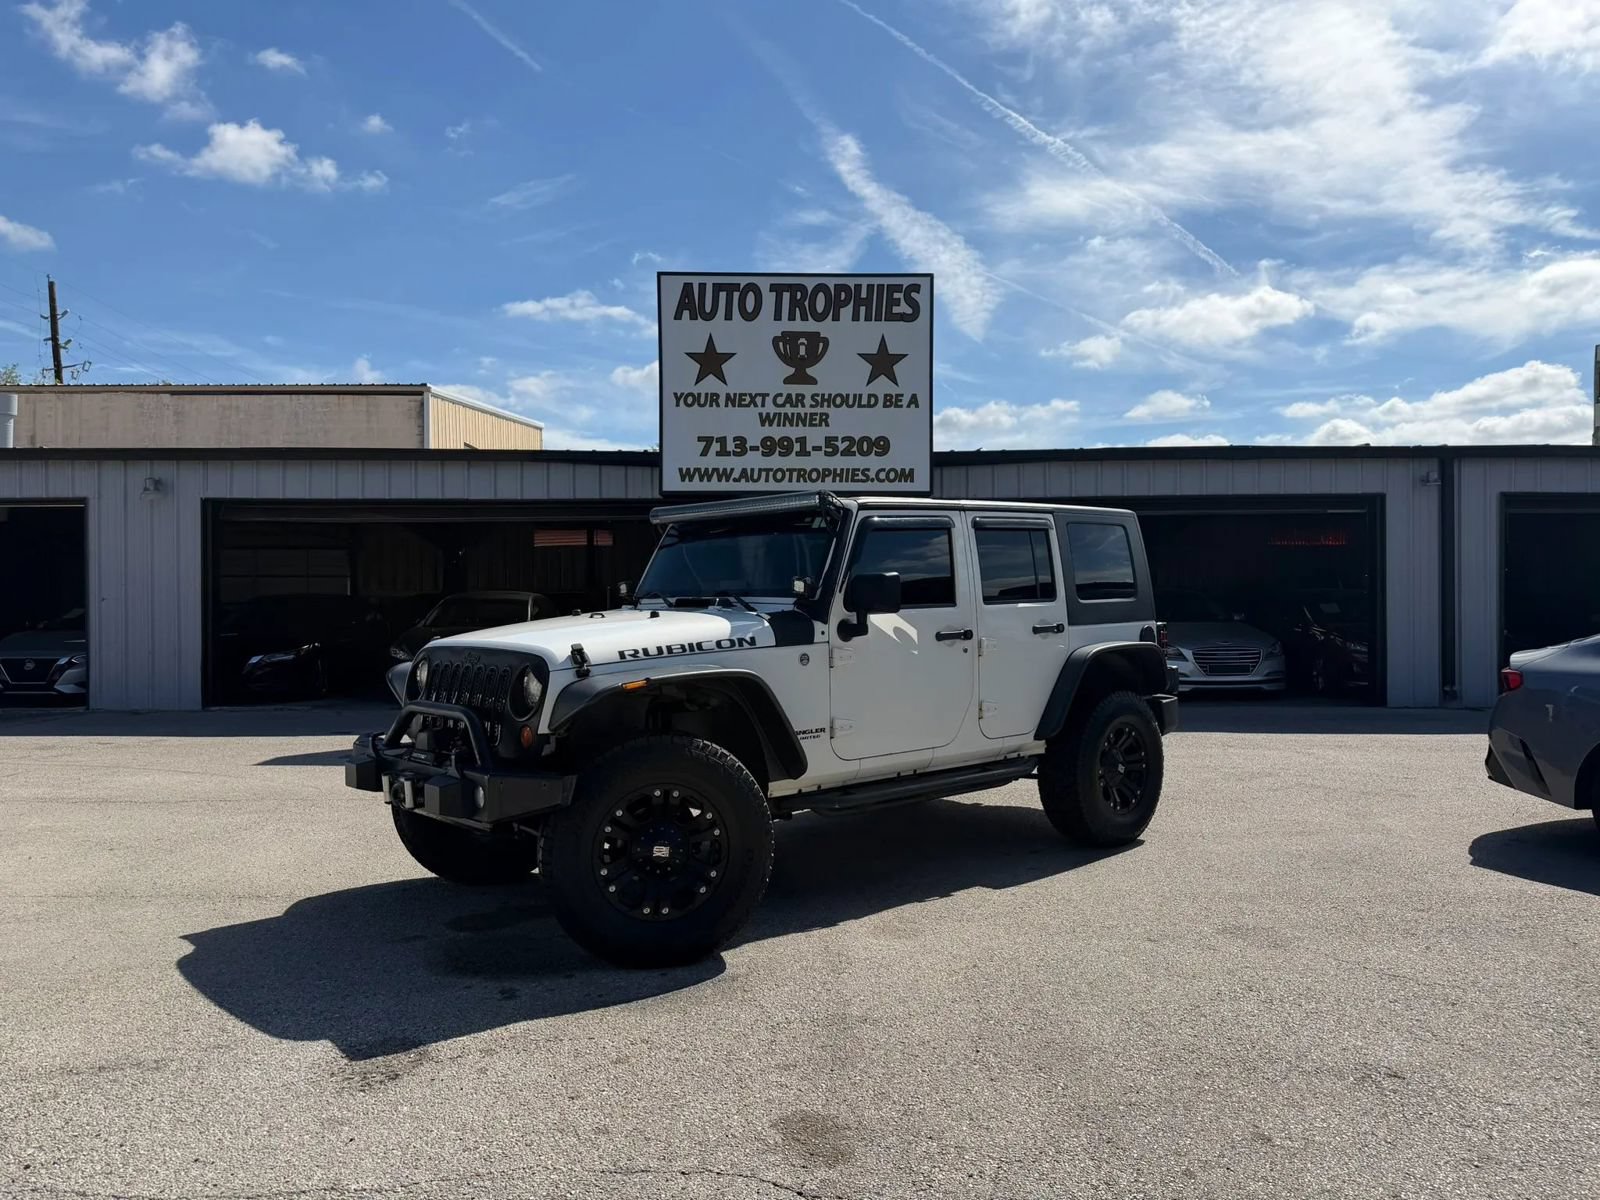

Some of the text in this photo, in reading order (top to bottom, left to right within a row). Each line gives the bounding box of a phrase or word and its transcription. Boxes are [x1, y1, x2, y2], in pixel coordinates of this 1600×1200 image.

[673, 282, 921, 323] AUTO TROPHIES
[673, 392, 919, 408] YOUR NEXT CAR SHOULD BE A
[758, 412, 830, 427] WINNER
[697, 436, 890, 457] 713-991-5209
[678, 467, 914, 483] WWW.AUTOTROPHIES.COM
[617, 636, 757, 660] RUBICON
[795, 727, 826, 736] ANGLER
